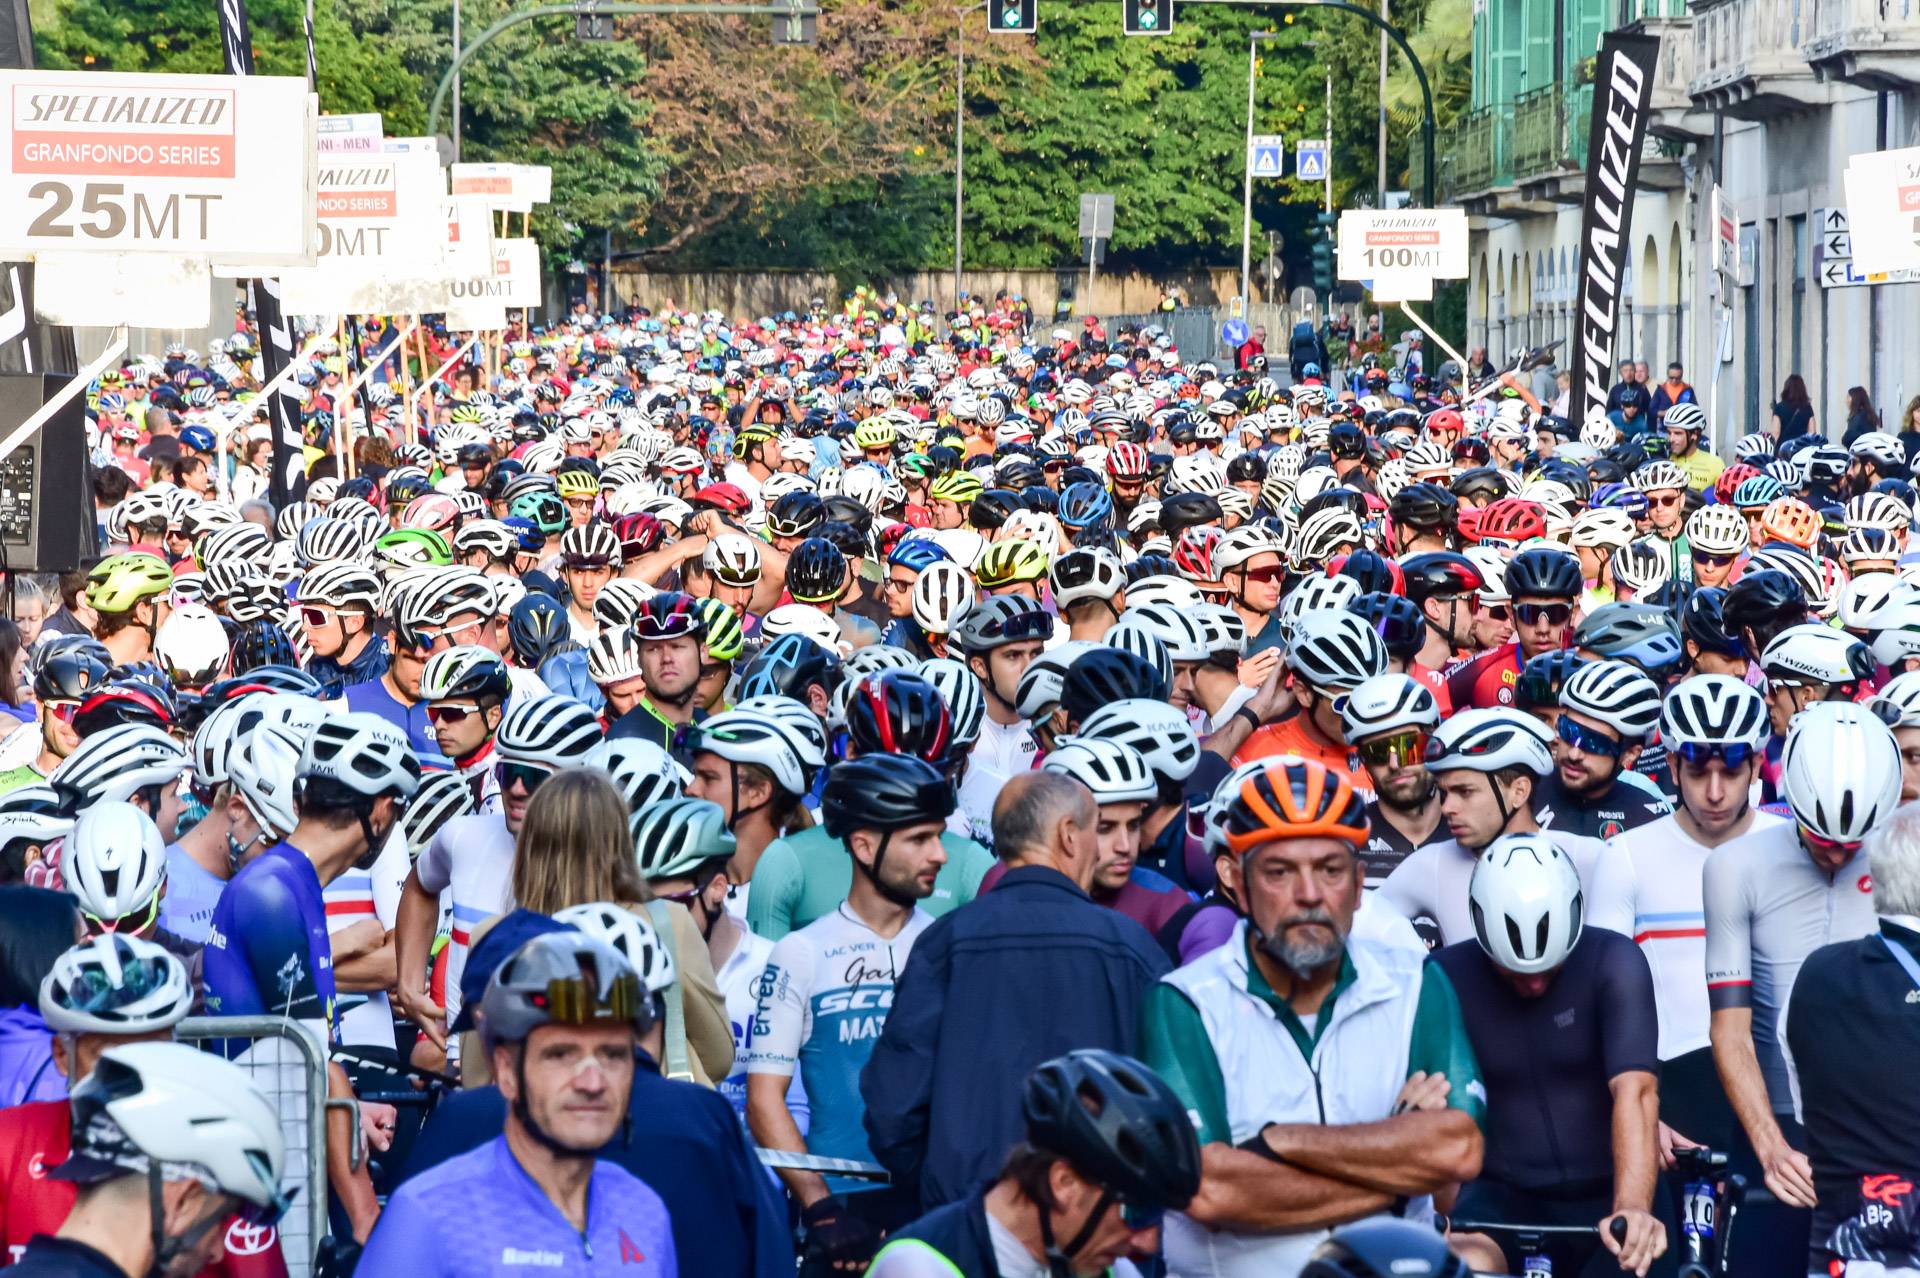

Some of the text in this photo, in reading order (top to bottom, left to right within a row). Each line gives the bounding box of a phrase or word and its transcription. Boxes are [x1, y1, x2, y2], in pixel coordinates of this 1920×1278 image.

[23, 94, 227, 125] SPECIALIZED
[23, 143, 221, 166] GRANFONDO SERIES
[344, 138, 370, 149] MEN
[27, 181, 222, 240] 25MT
[350, 197, 388, 210] SERIES
[1583, 48, 1645, 422] SPECIALIZED
[1363, 248, 1448, 268] 100MT
[1776, 652, 1832, 679] S-WORKS
[502, 1247, 564, 1268] Santini
